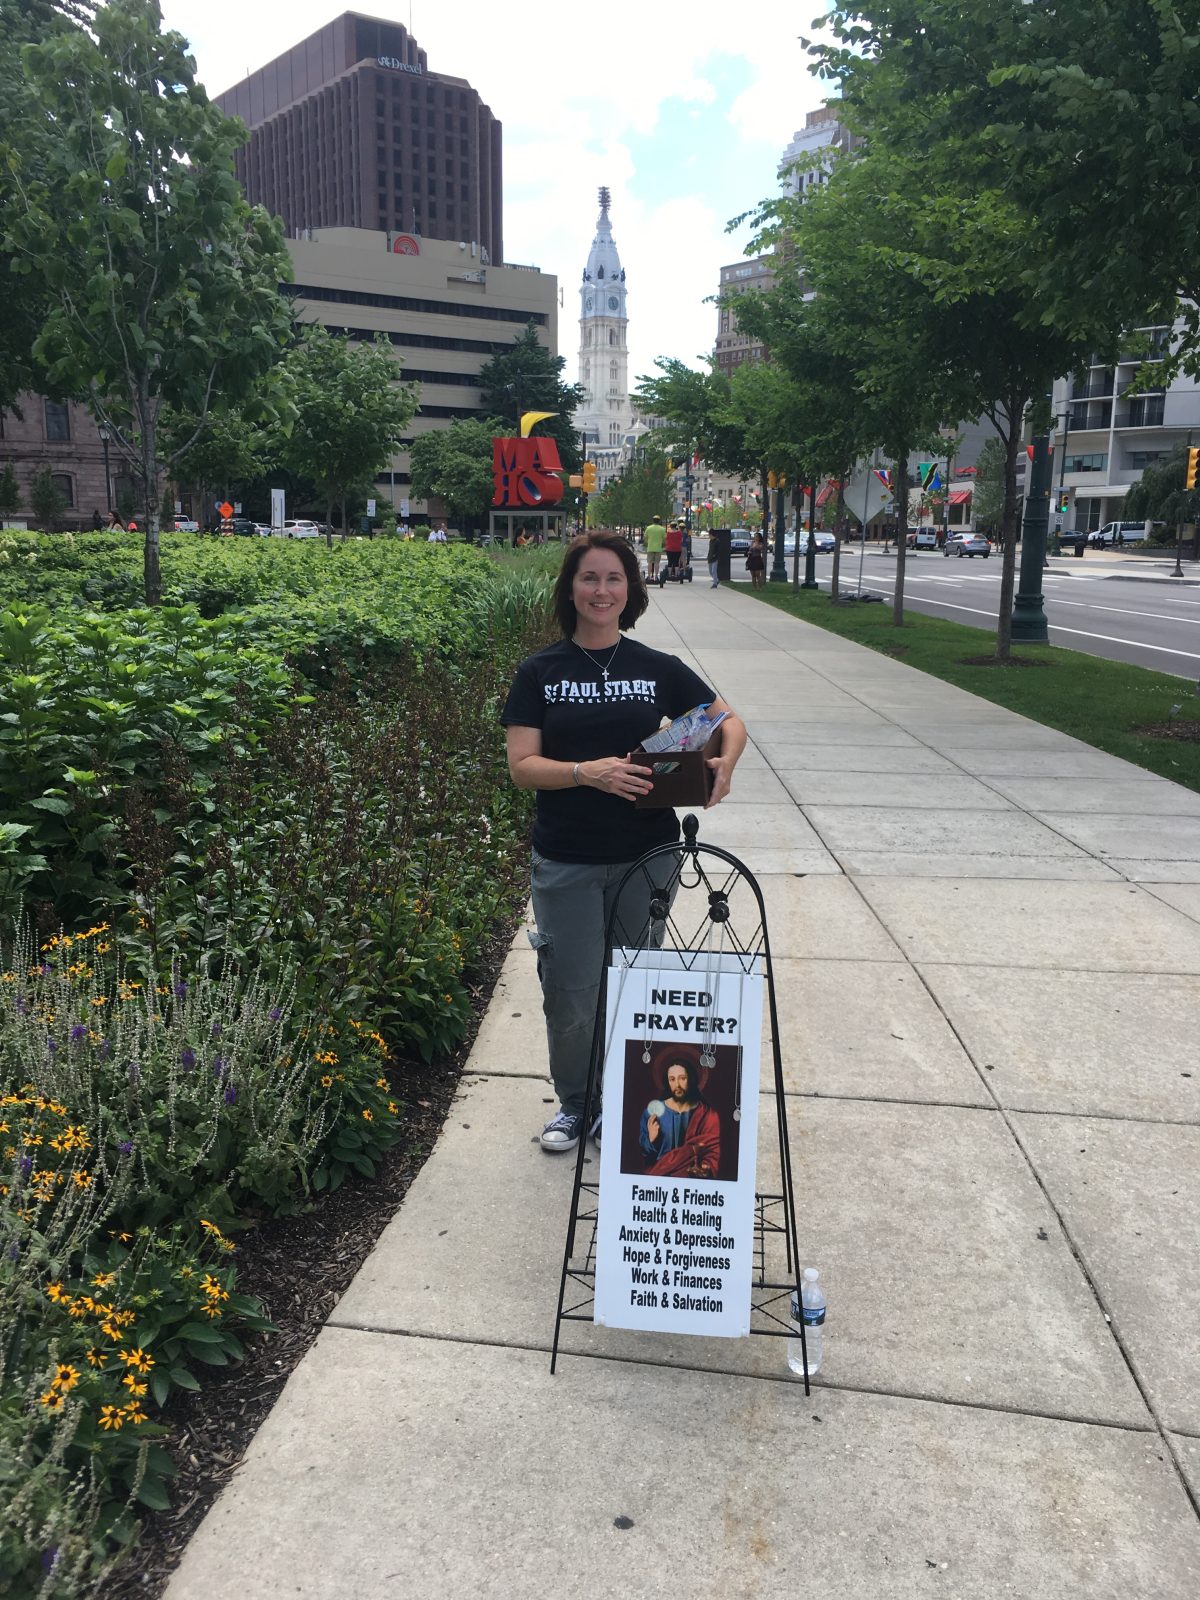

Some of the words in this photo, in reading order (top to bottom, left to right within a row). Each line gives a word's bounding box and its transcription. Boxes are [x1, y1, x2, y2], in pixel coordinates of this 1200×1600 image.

[391, 57, 422, 74] Drexel
[561, 680, 600, 697] PAUL
[604, 679, 656, 697] STREET
[546, 695, 655, 705] VANGELIZATION
[651, 989, 713, 1008] NEED
[633, 1012, 738, 1034] PRAYER?
[631, 1184, 669, 1207] Family
[671, 1187, 680, 1204] &
[683, 1188, 725, 1207] Friends
[632, 1205, 667, 1223] Health
[670, 1208, 679, 1225] &
[681, 1209, 722, 1232] Healing
[618, 1225, 660, 1248] Anxiety
[663, 1228, 671, 1245] &
[674, 1229, 735, 1250] Depression
[623, 1245, 651, 1267] Hope
[654, 1248, 662, 1265] &
[665, 1249, 731, 1271] Forgiveness
[631, 1267, 659, 1285] Work
[662, 1269, 670, 1286] &
[673, 1270, 723, 1291] Finances
[630, 1289, 658, 1308] Faith
[661, 1292, 669, 1309] &
[672, 1293, 723, 1313] Salvation
